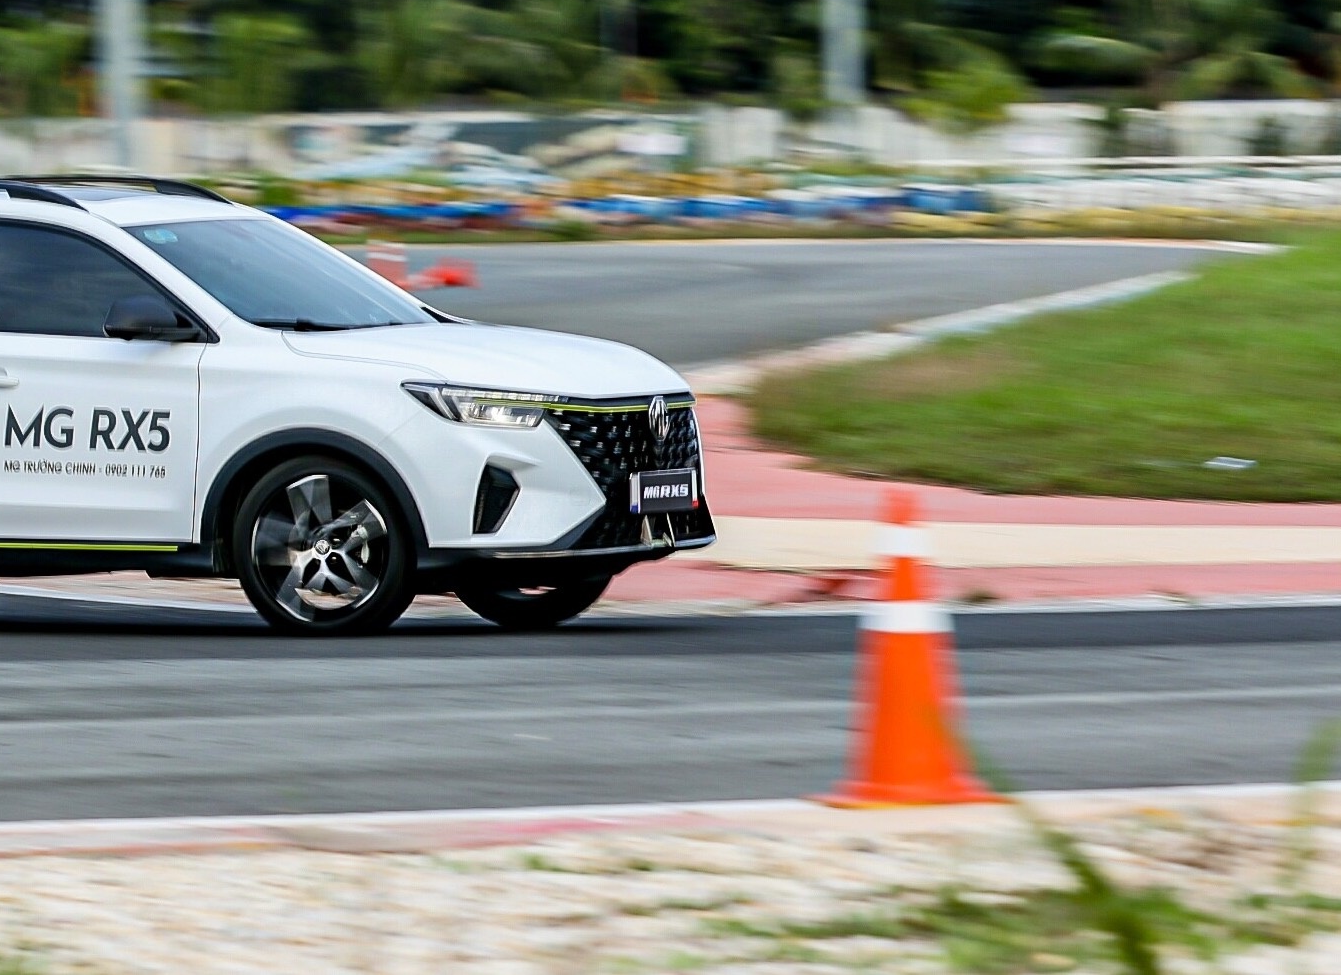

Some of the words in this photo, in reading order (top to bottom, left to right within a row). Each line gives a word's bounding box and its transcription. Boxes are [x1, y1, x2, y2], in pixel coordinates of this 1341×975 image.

[4, 404, 74, 450] MG
[89, 407, 171, 453] RX5
[4, 460, 20, 473] MG
[131, 464, 146, 477] 111
